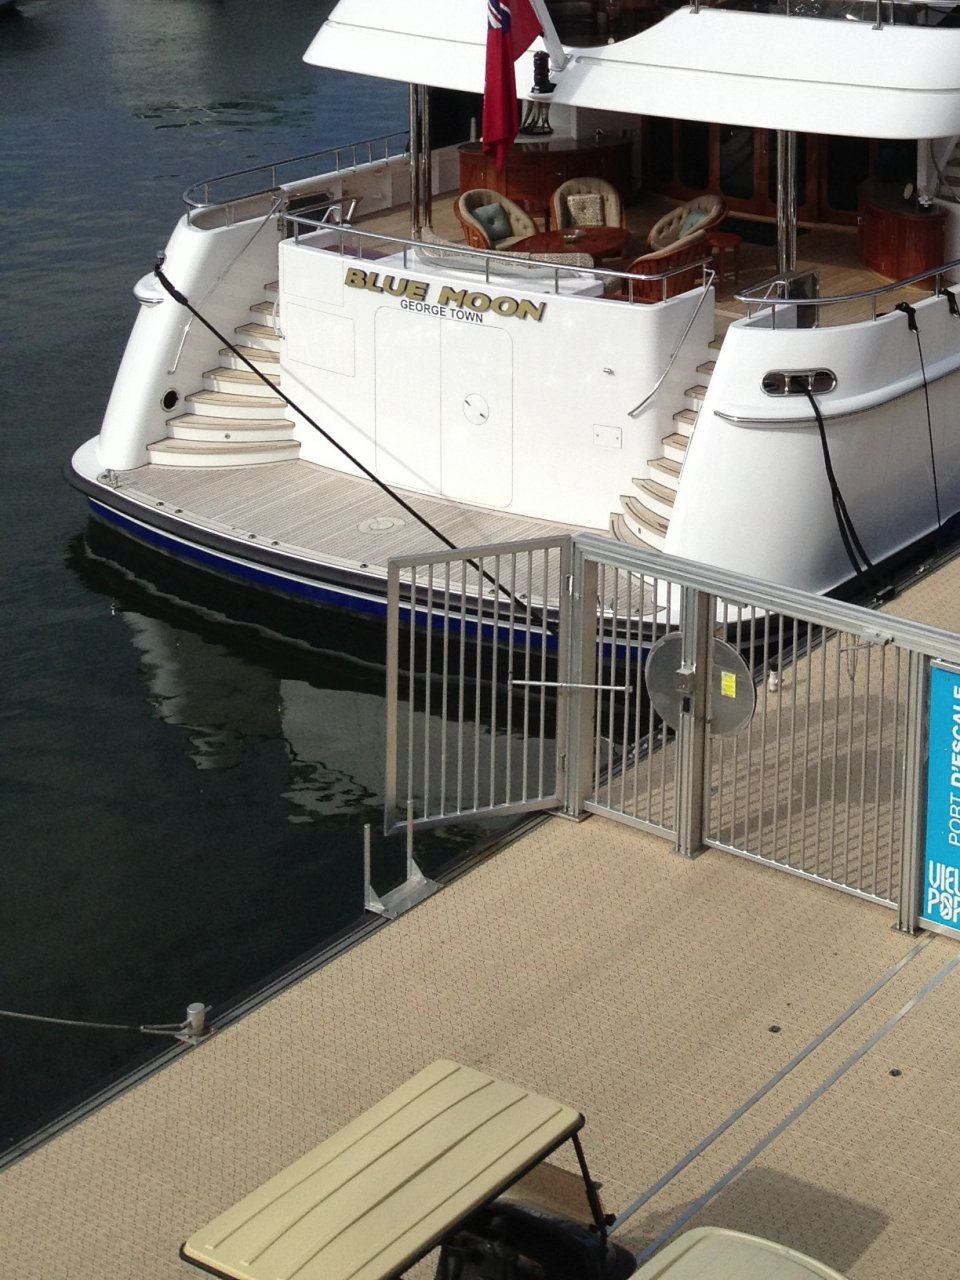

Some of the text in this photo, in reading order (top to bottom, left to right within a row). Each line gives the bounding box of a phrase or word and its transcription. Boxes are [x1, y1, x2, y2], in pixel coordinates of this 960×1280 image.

[344, 267, 547, 322] BLUE MOON
[400, 299, 484, 324] GEORGE TOWN
